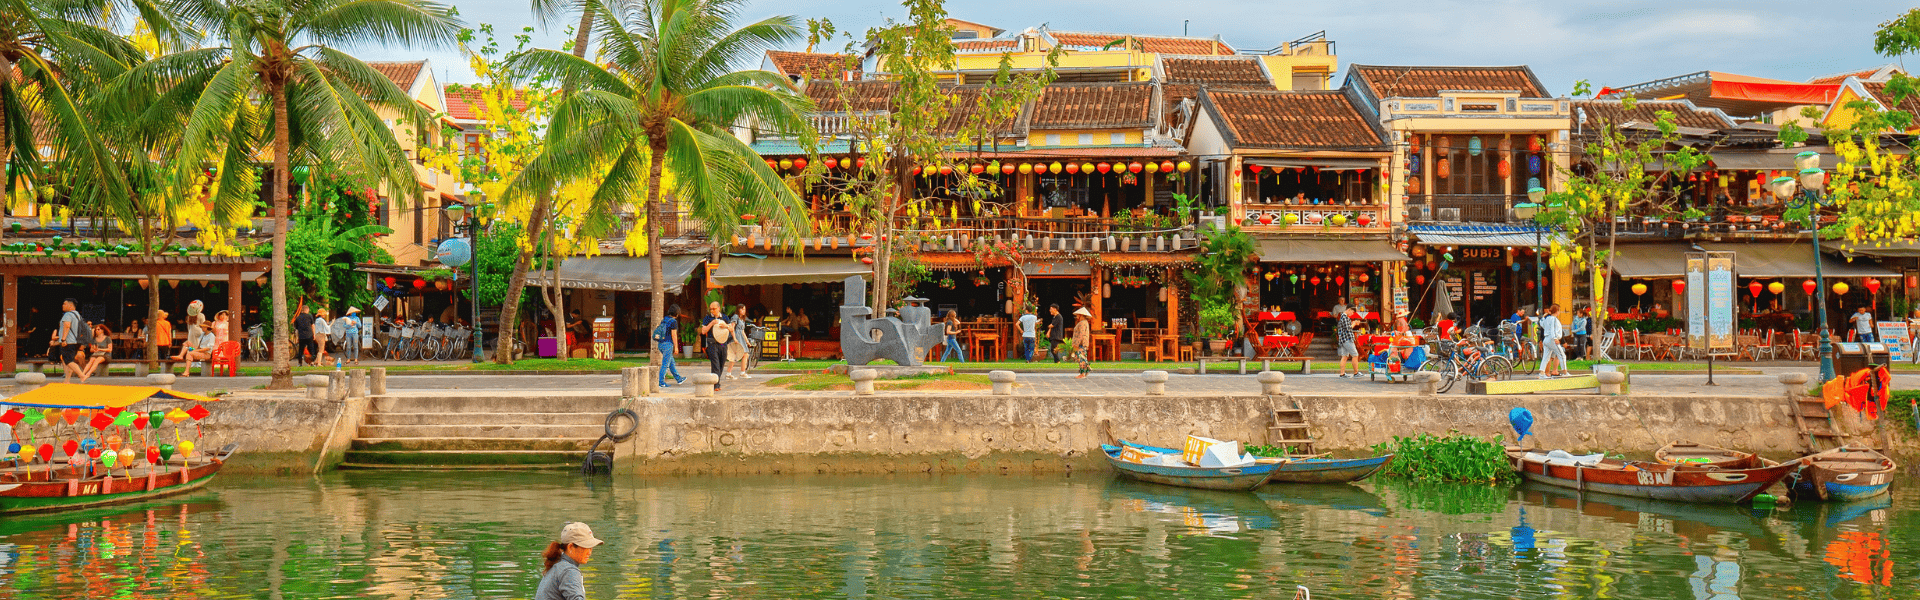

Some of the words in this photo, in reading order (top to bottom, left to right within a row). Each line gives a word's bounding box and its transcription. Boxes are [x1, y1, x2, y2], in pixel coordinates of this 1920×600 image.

[1037, 263, 1053, 274] 27
[603, 282, 631, 291] SPA
[593, 342, 610, 360] SPA
[1636, 471, 1654, 485] 083
[82, 483, 98, 495] MA
